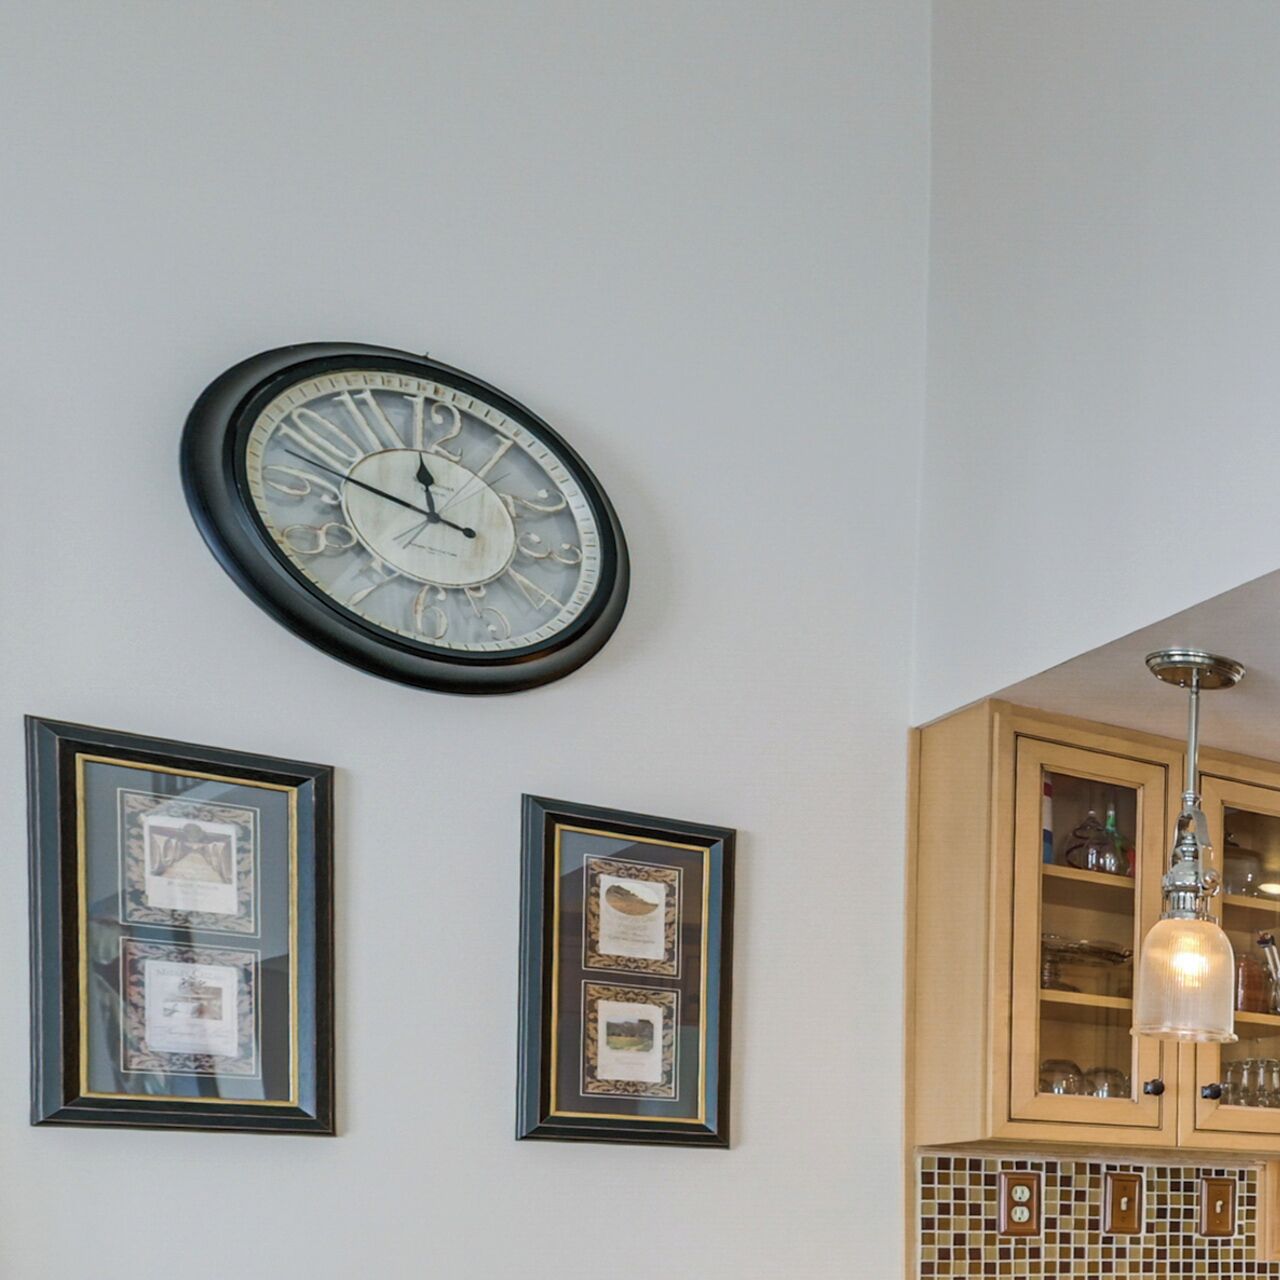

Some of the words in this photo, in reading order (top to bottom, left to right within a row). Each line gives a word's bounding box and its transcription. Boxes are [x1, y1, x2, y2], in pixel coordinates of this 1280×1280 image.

[276, 406, 366, 473] 10
[332, 389, 407, 450] 11
[403, 394, 463, 462] 12
[476, 433, 514, 476] 1
[262, 463, 344, 505] 9
[500, 488, 568, 518] 2
[283, 521, 357, 555] 8
[517, 532, 584, 565] 3
[507, 566, 566, 610] 4
[411, 583, 449, 639] 6
[464, 583, 511, 640] 5
